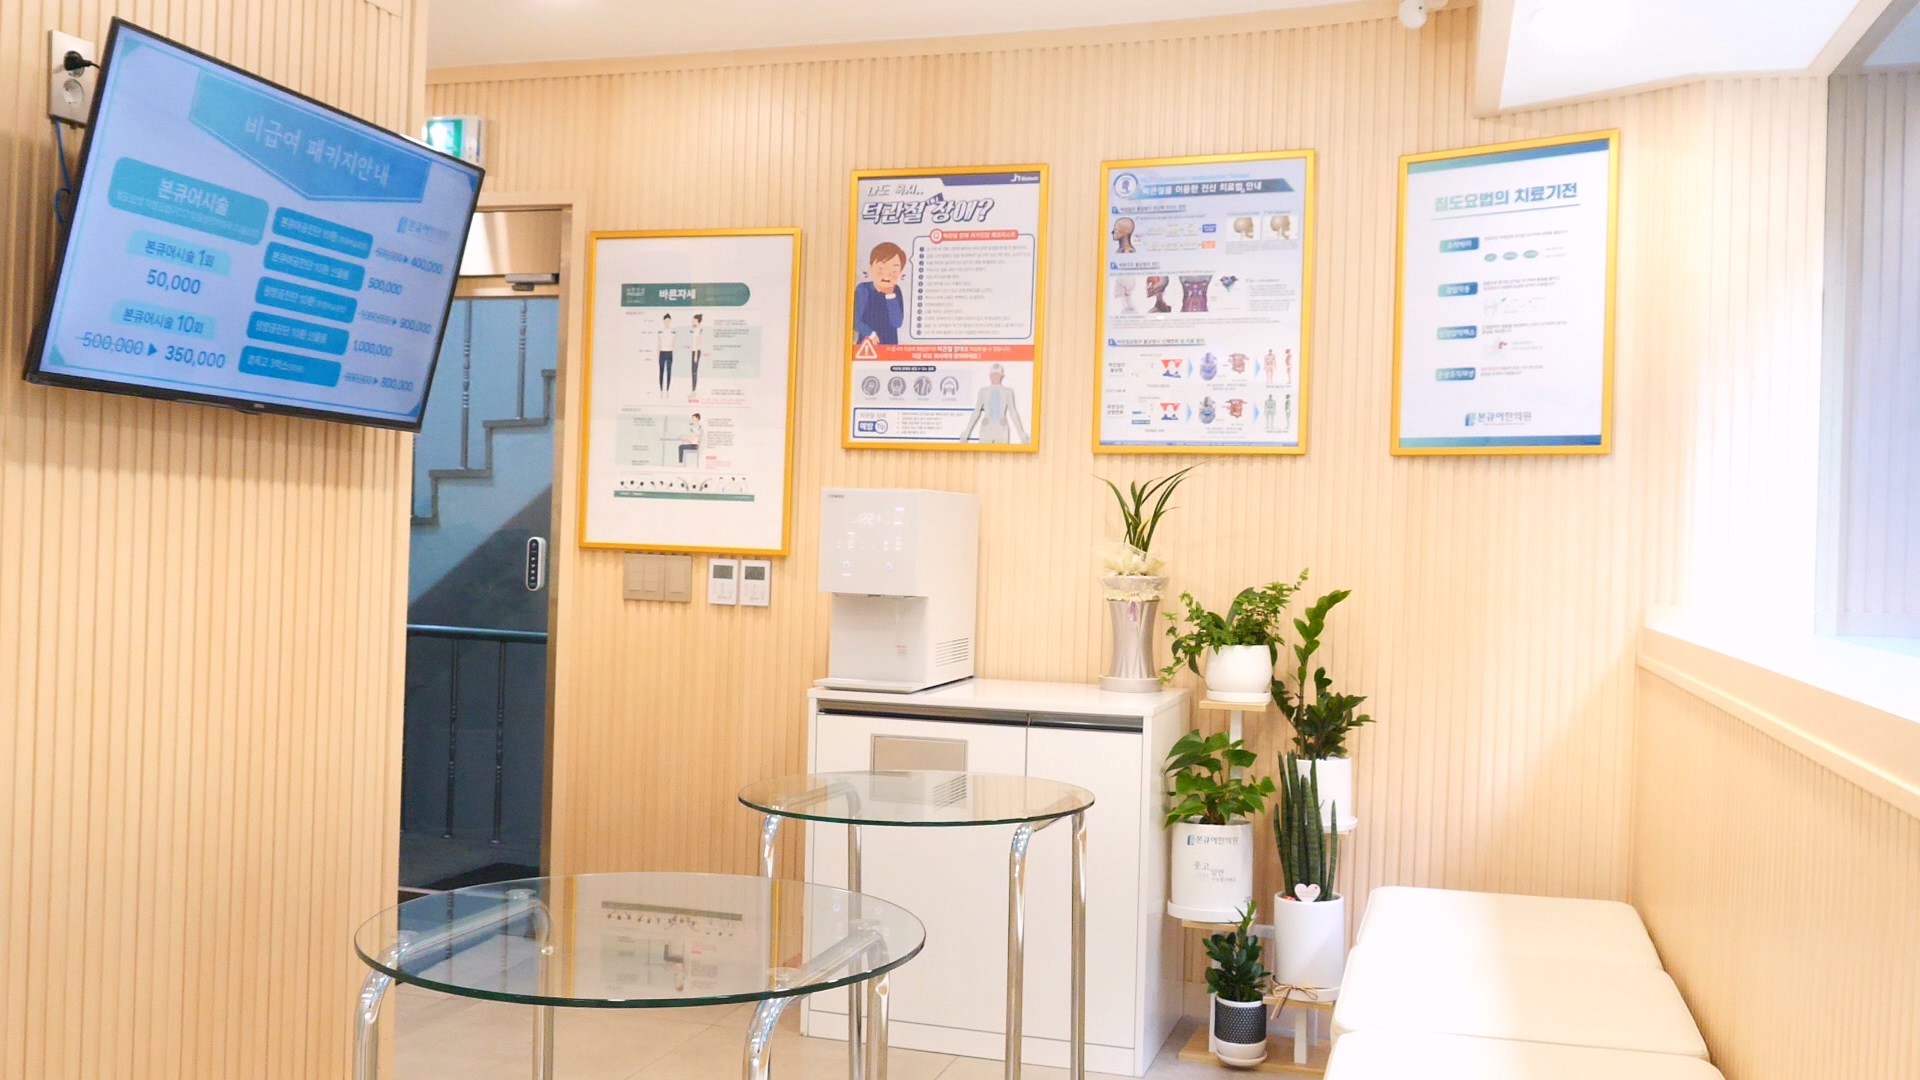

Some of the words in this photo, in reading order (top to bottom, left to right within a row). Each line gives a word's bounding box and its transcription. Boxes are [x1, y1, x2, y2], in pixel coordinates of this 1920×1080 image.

[245, 115, 302, 155] 비급여
[307, 138, 391, 187] 패키지안내
[157, 178, 230, 217] 본큐어시술
[1434, 189, 1509, 212] 침도요법의
[1514, 182, 1577, 203] 치료기전
[862, 200, 927, 225] 턱관절
[145, 239, 195, 265] 본큐어시술
[198, 249, 215, 267] 1회
[411, 256, 443, 274] 400,000
[146, 269, 201, 295] 50,000
[368, 277, 403, 296] 500,000
[658, 288, 697, 301] 바른자세
[123, 307, 174, 331] 본큐어시술
[177, 314, 204, 334] 10회
[80, 331, 144, 356] 500,000
[164, 345, 226, 369] 350,000
[353, 340, 393, 357] 1,000,000
